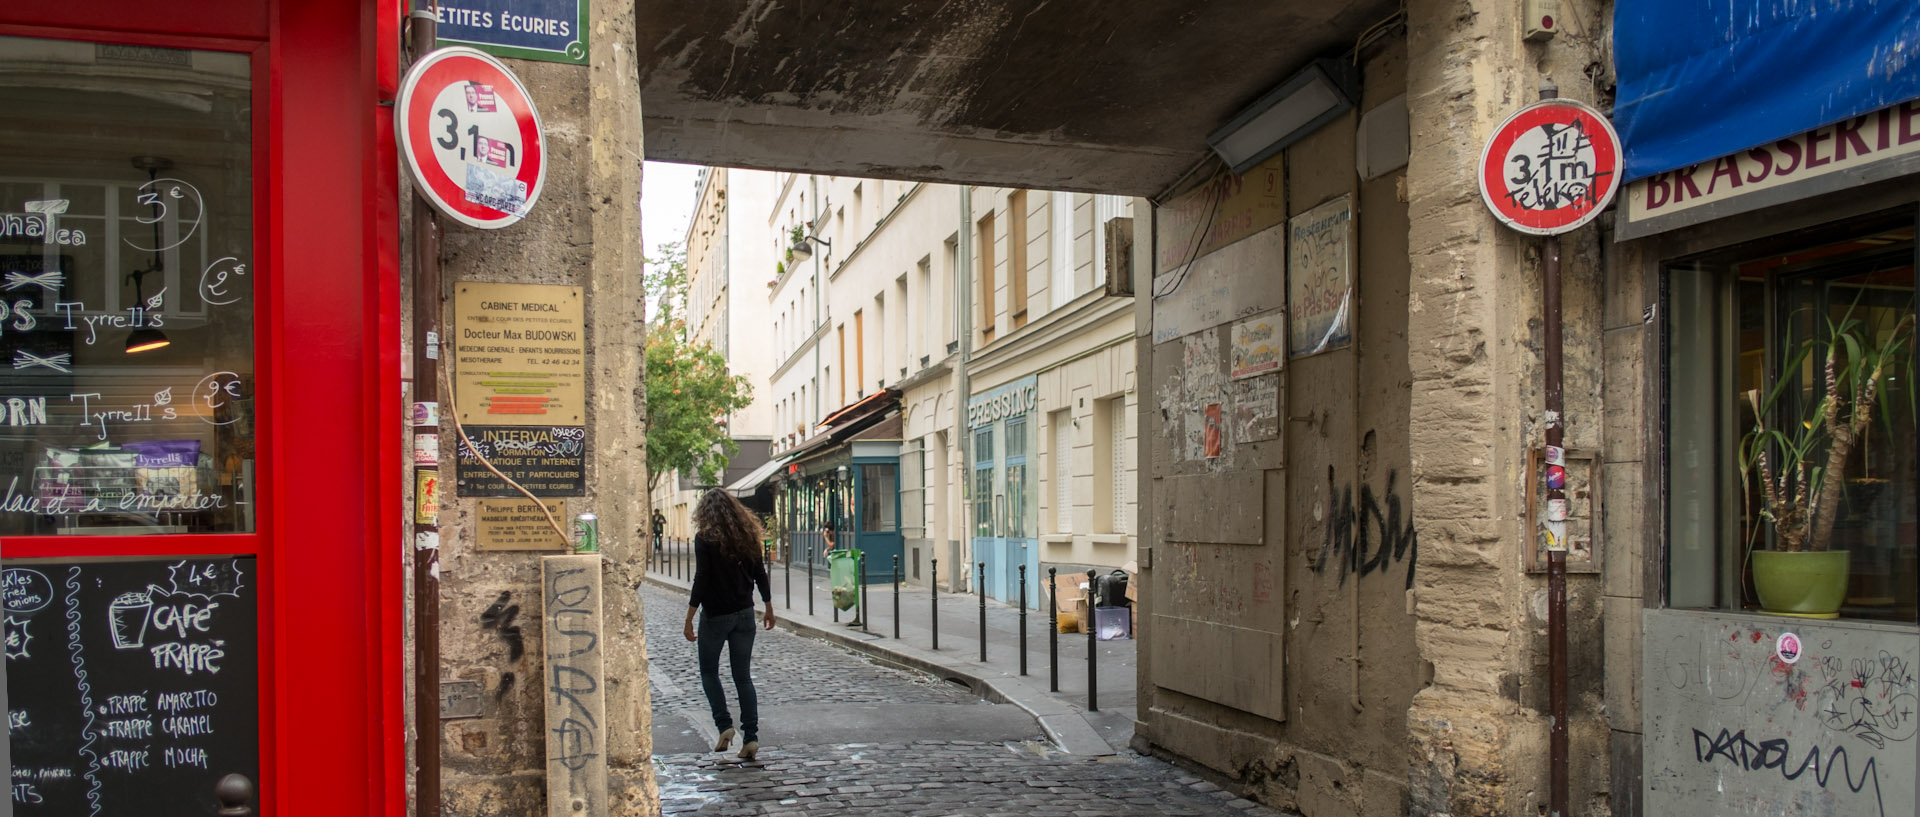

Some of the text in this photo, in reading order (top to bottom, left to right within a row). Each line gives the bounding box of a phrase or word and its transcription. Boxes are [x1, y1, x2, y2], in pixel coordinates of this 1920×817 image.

[501, 11, 570, 36] ÉCURIES
[1646, 101, 1920, 211] BRASSERIE
[481, 302, 559, 312] CABINET MEDICAL
[464, 328, 576, 341] Docteur Max BUDOWSKI
[968, 384, 1037, 428] PRESSING
[483, 430, 558, 443] INTERVAL
[498, 449, 546, 457] FORMATION
[461, 458, 581, 466] INFOMATIQUE ET INTERNET
[529, 471, 580, 479] PARTICULIERS
[119, 490, 228, 518] emporter
[517, 505, 557, 513] BERTRND
[165, 747, 208, 769] MOCHA
